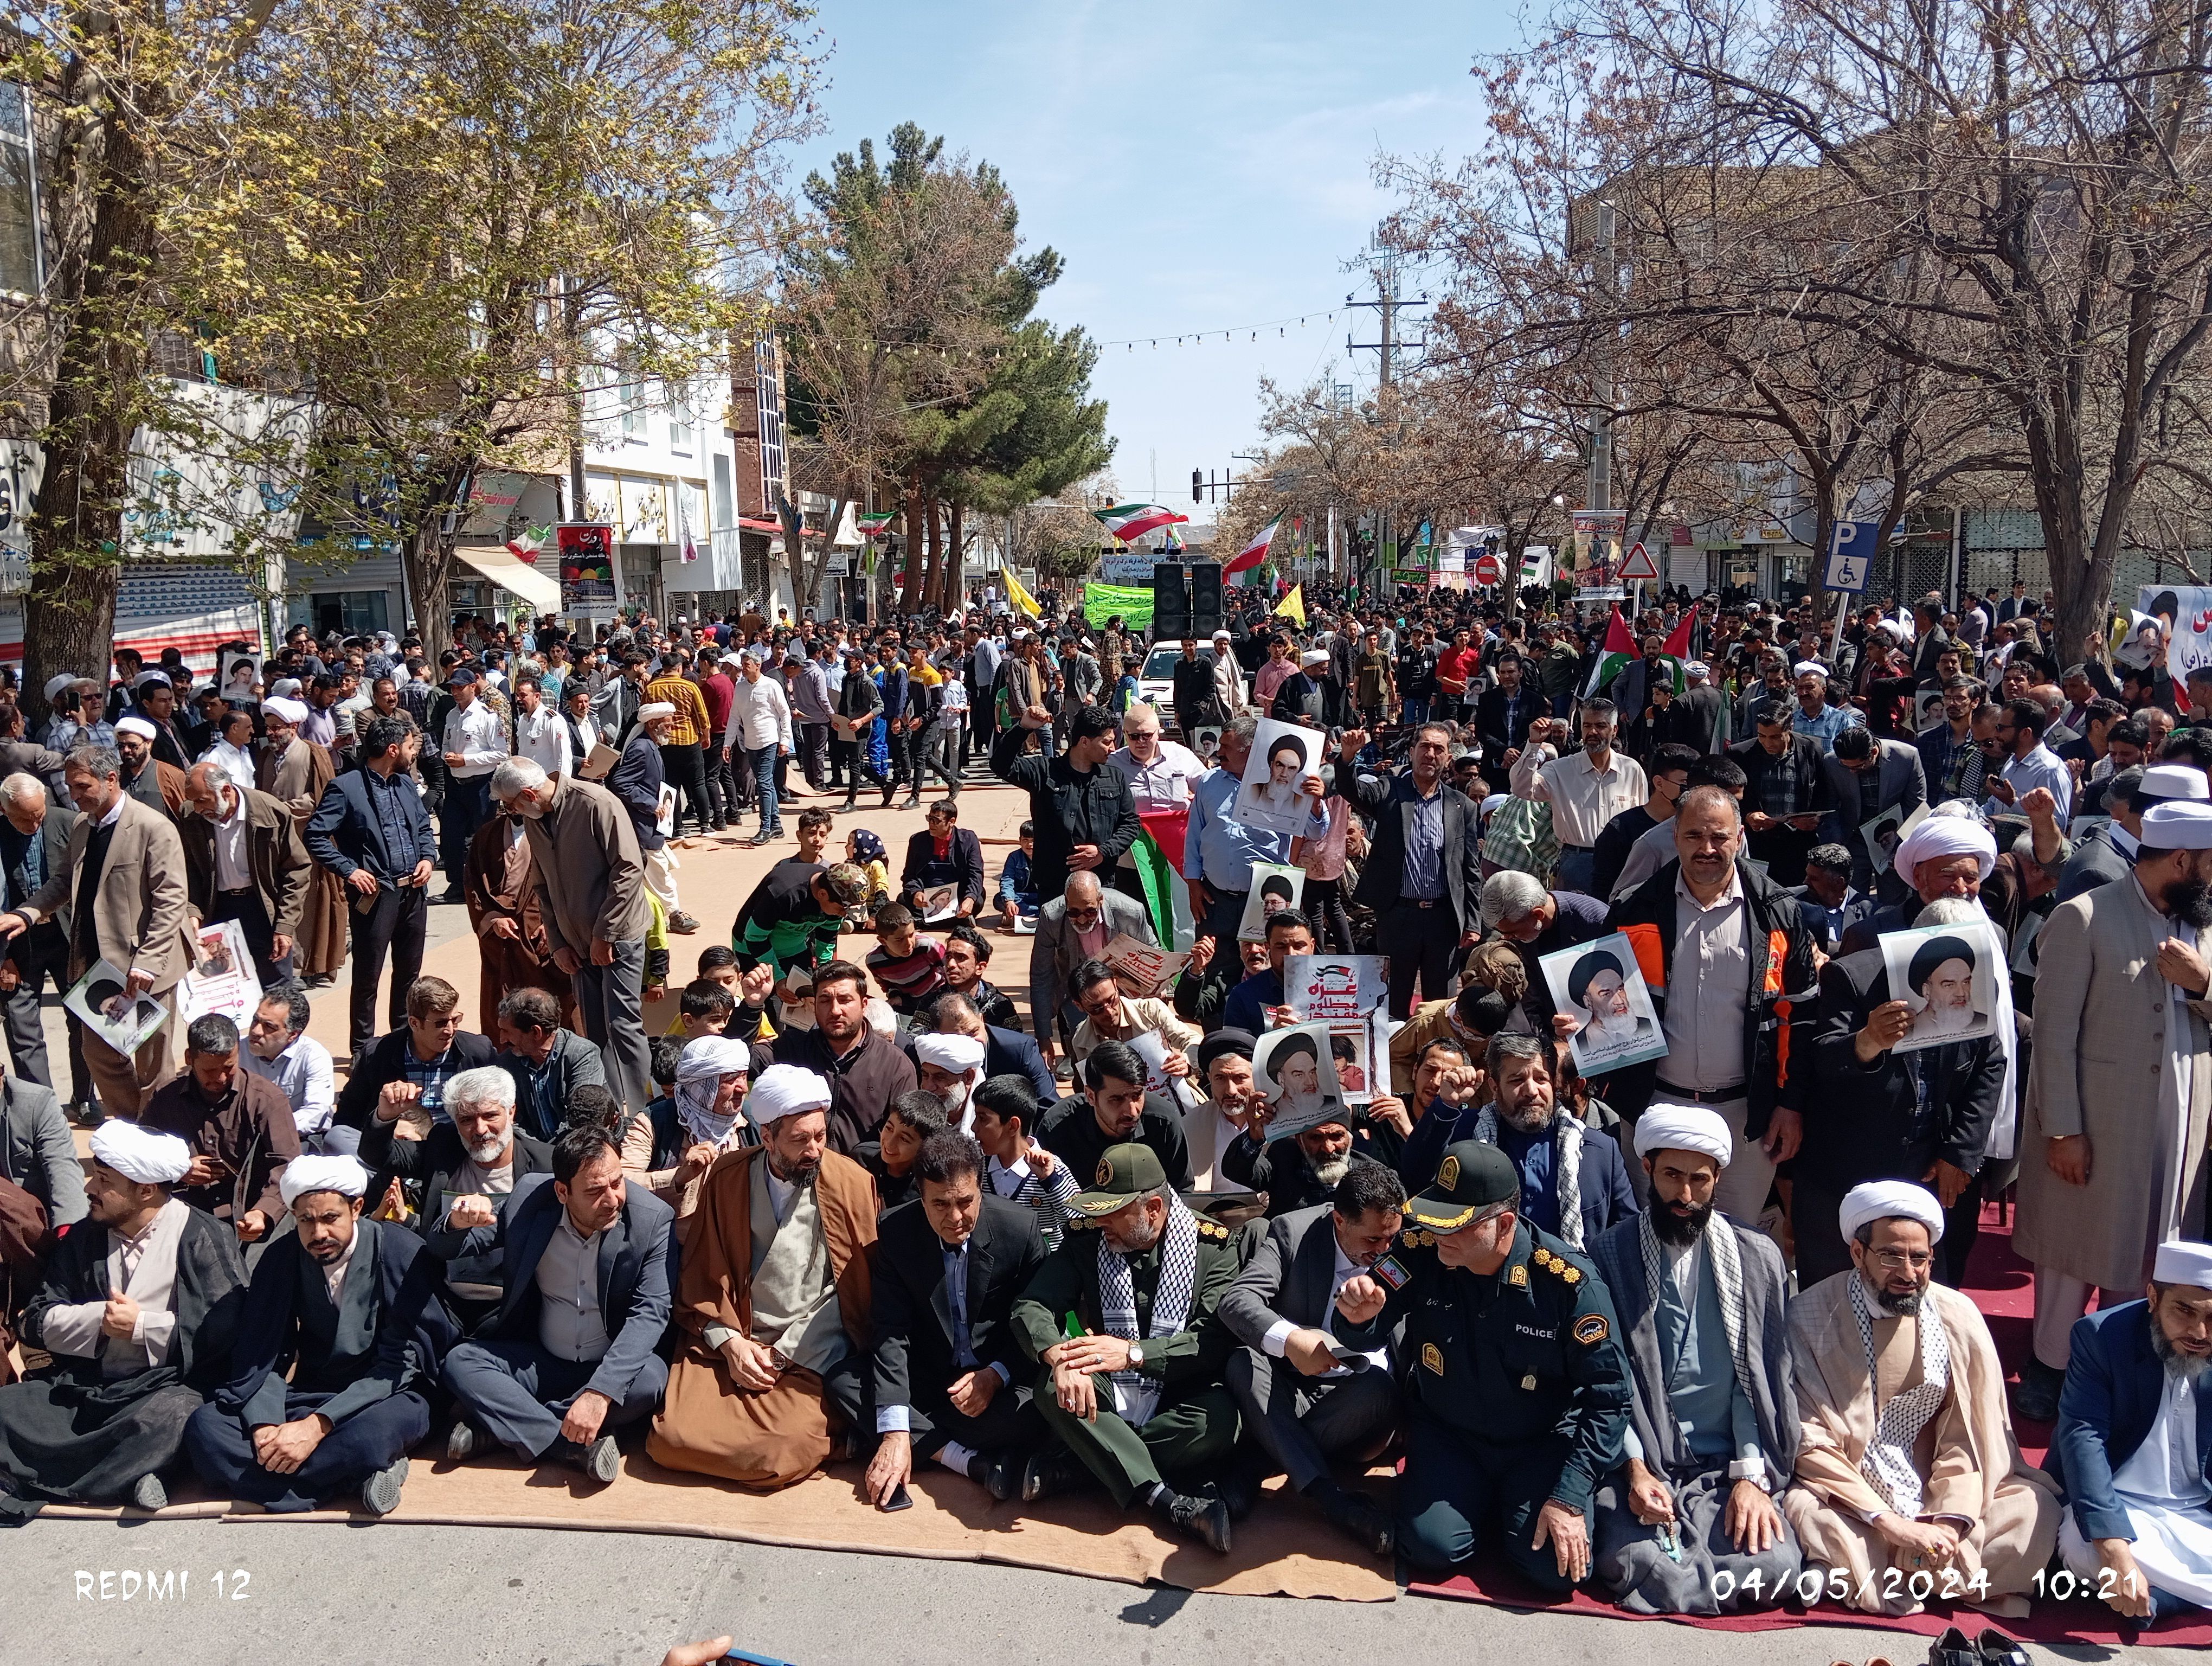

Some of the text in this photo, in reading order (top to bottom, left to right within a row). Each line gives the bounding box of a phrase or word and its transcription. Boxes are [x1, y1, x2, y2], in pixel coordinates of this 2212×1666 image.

[1833, 522, 1857, 555] P
[1308, 978, 1358, 1000] غزه
[1309, 997, 1359, 1011] مظلوم
[1309, 1009, 1359, 1021] مقتدر
[1592, 1046, 1606, 1054] اسلامی
[1515, 1324, 1553, 1339] POLICE
